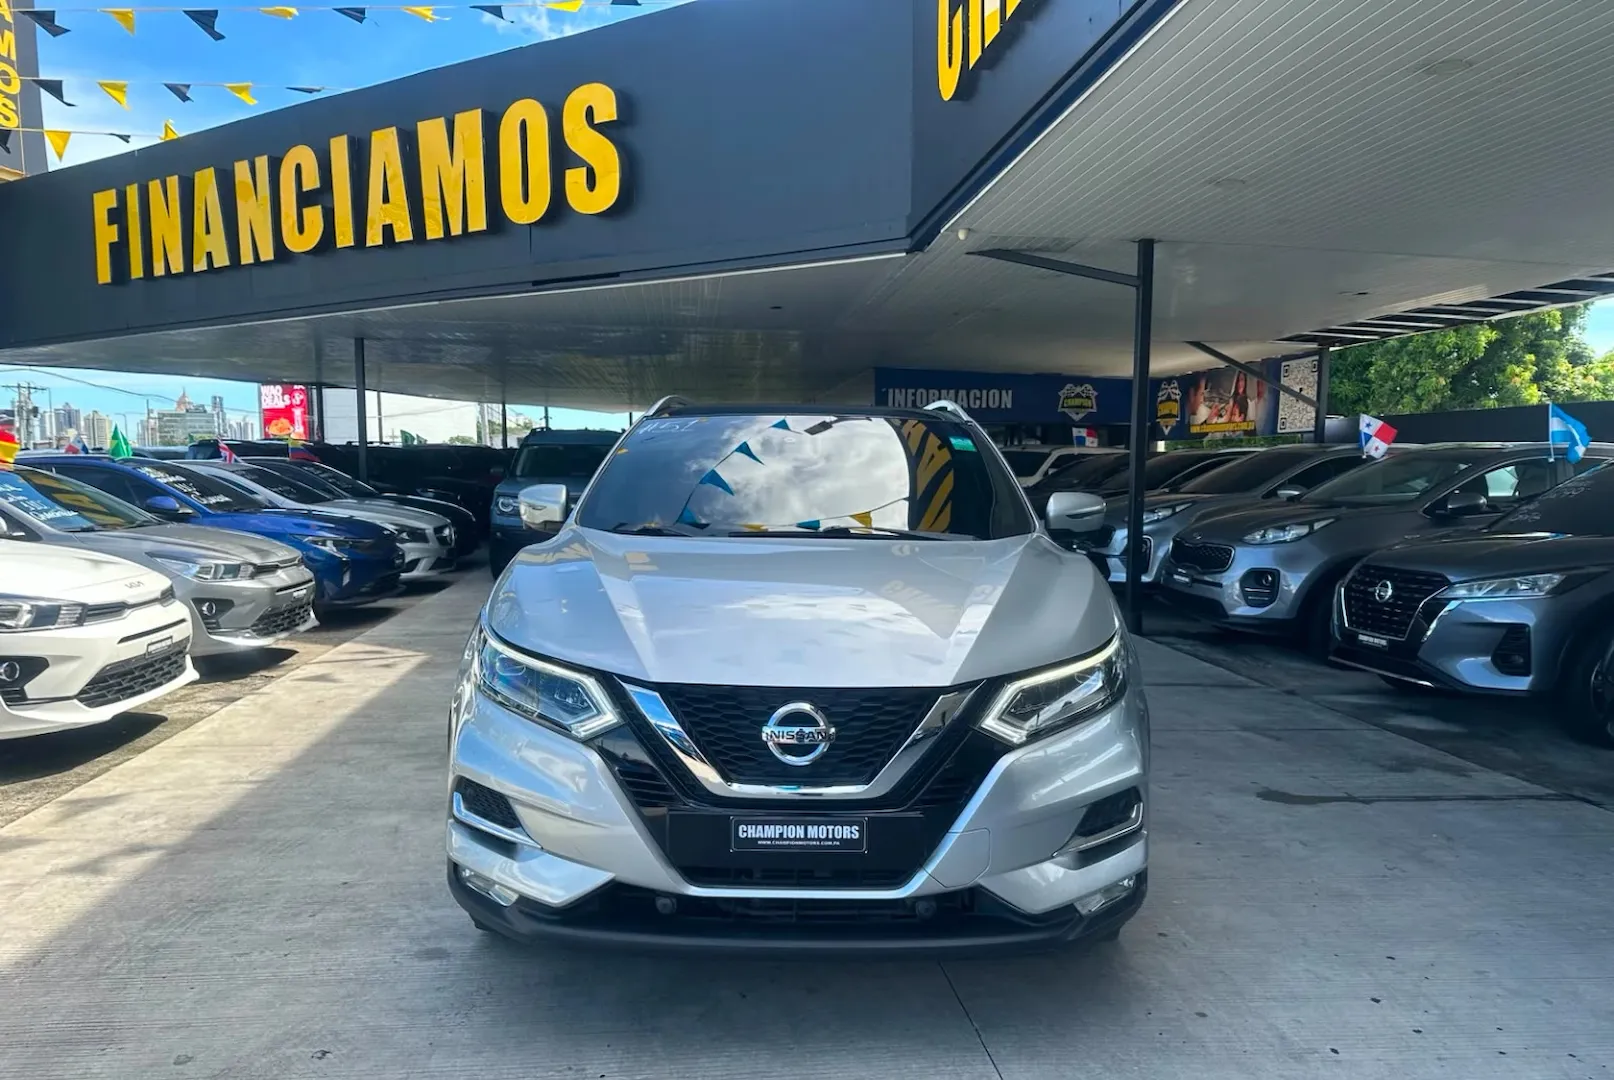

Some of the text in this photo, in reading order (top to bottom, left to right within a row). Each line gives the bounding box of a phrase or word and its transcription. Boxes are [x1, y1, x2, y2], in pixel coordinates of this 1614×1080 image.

[93, 82, 621, 285] FINANCIAMOS
[769, 730, 827, 740] NISSAN
[738, 824, 860, 839] CHAMPION MOTORS
